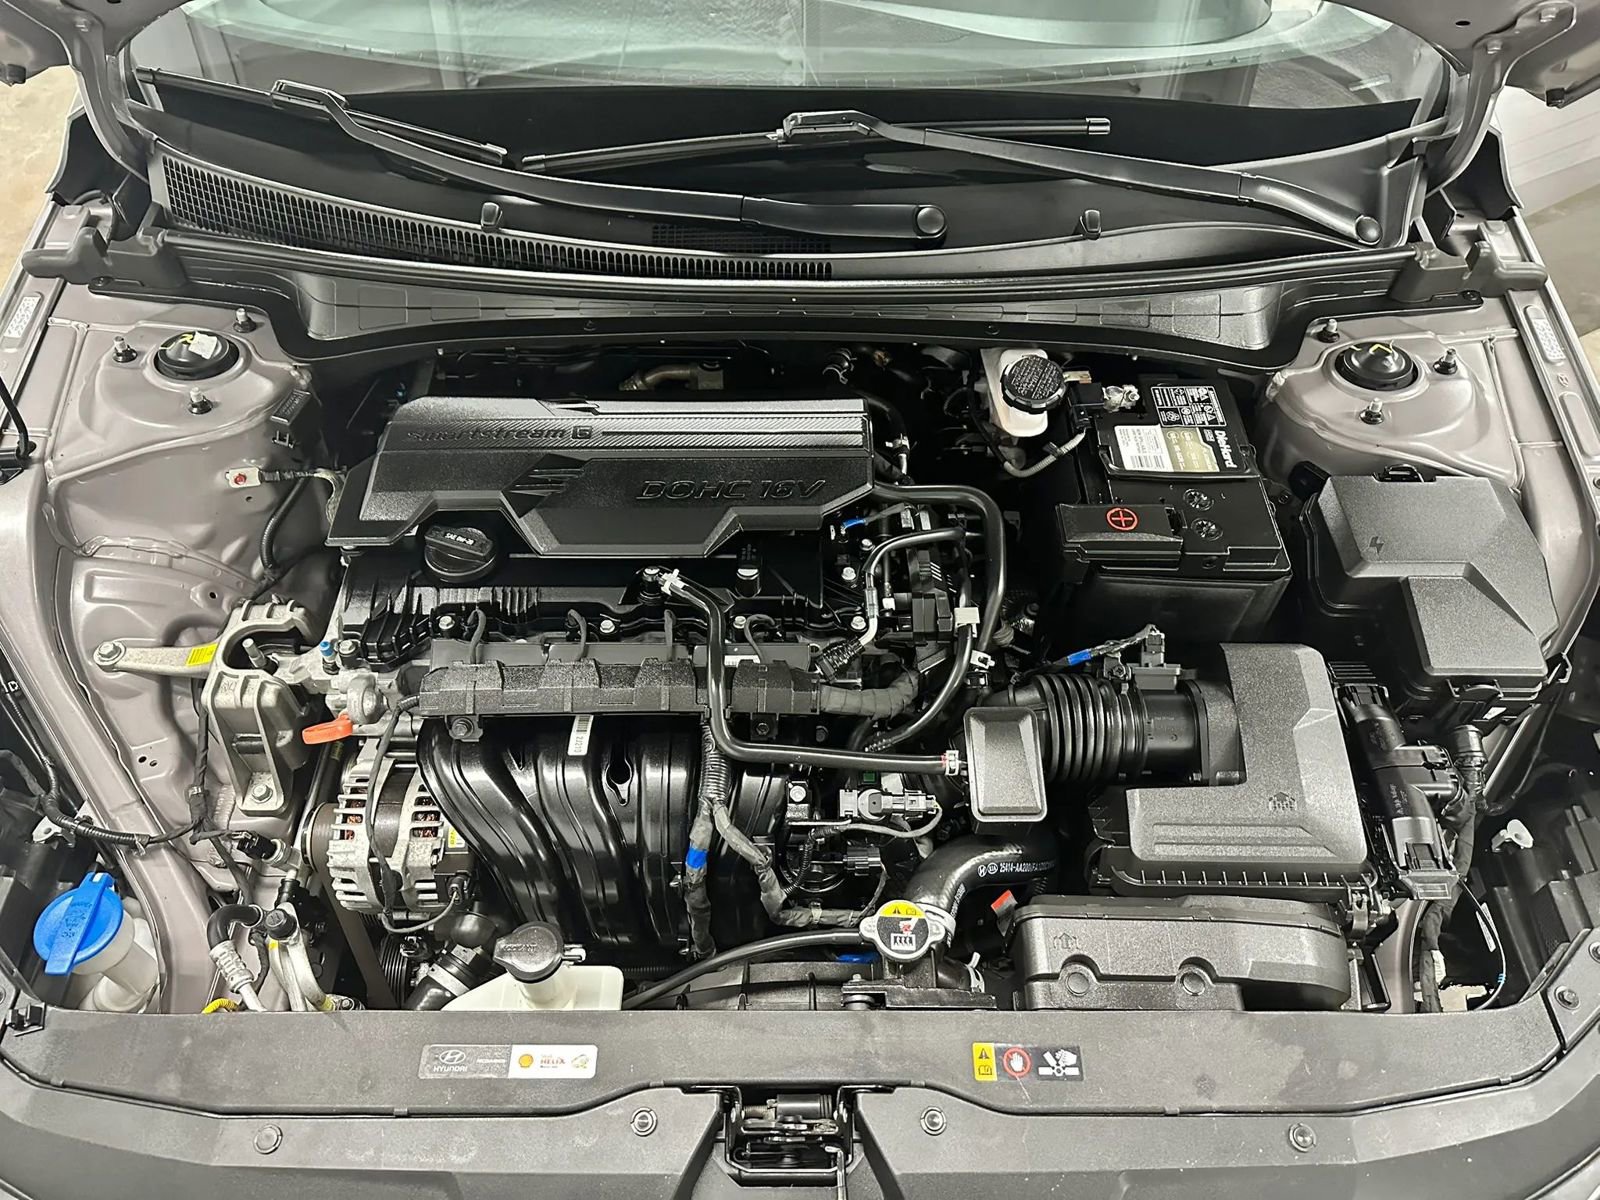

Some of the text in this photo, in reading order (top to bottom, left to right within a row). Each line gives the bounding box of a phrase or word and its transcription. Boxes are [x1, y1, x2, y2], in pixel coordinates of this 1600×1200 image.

[1214, 430, 1238, 468] DieHard
[635, 479, 826, 500] DOHC 16V
[433, 1065, 468, 1073] HYUNDAI
